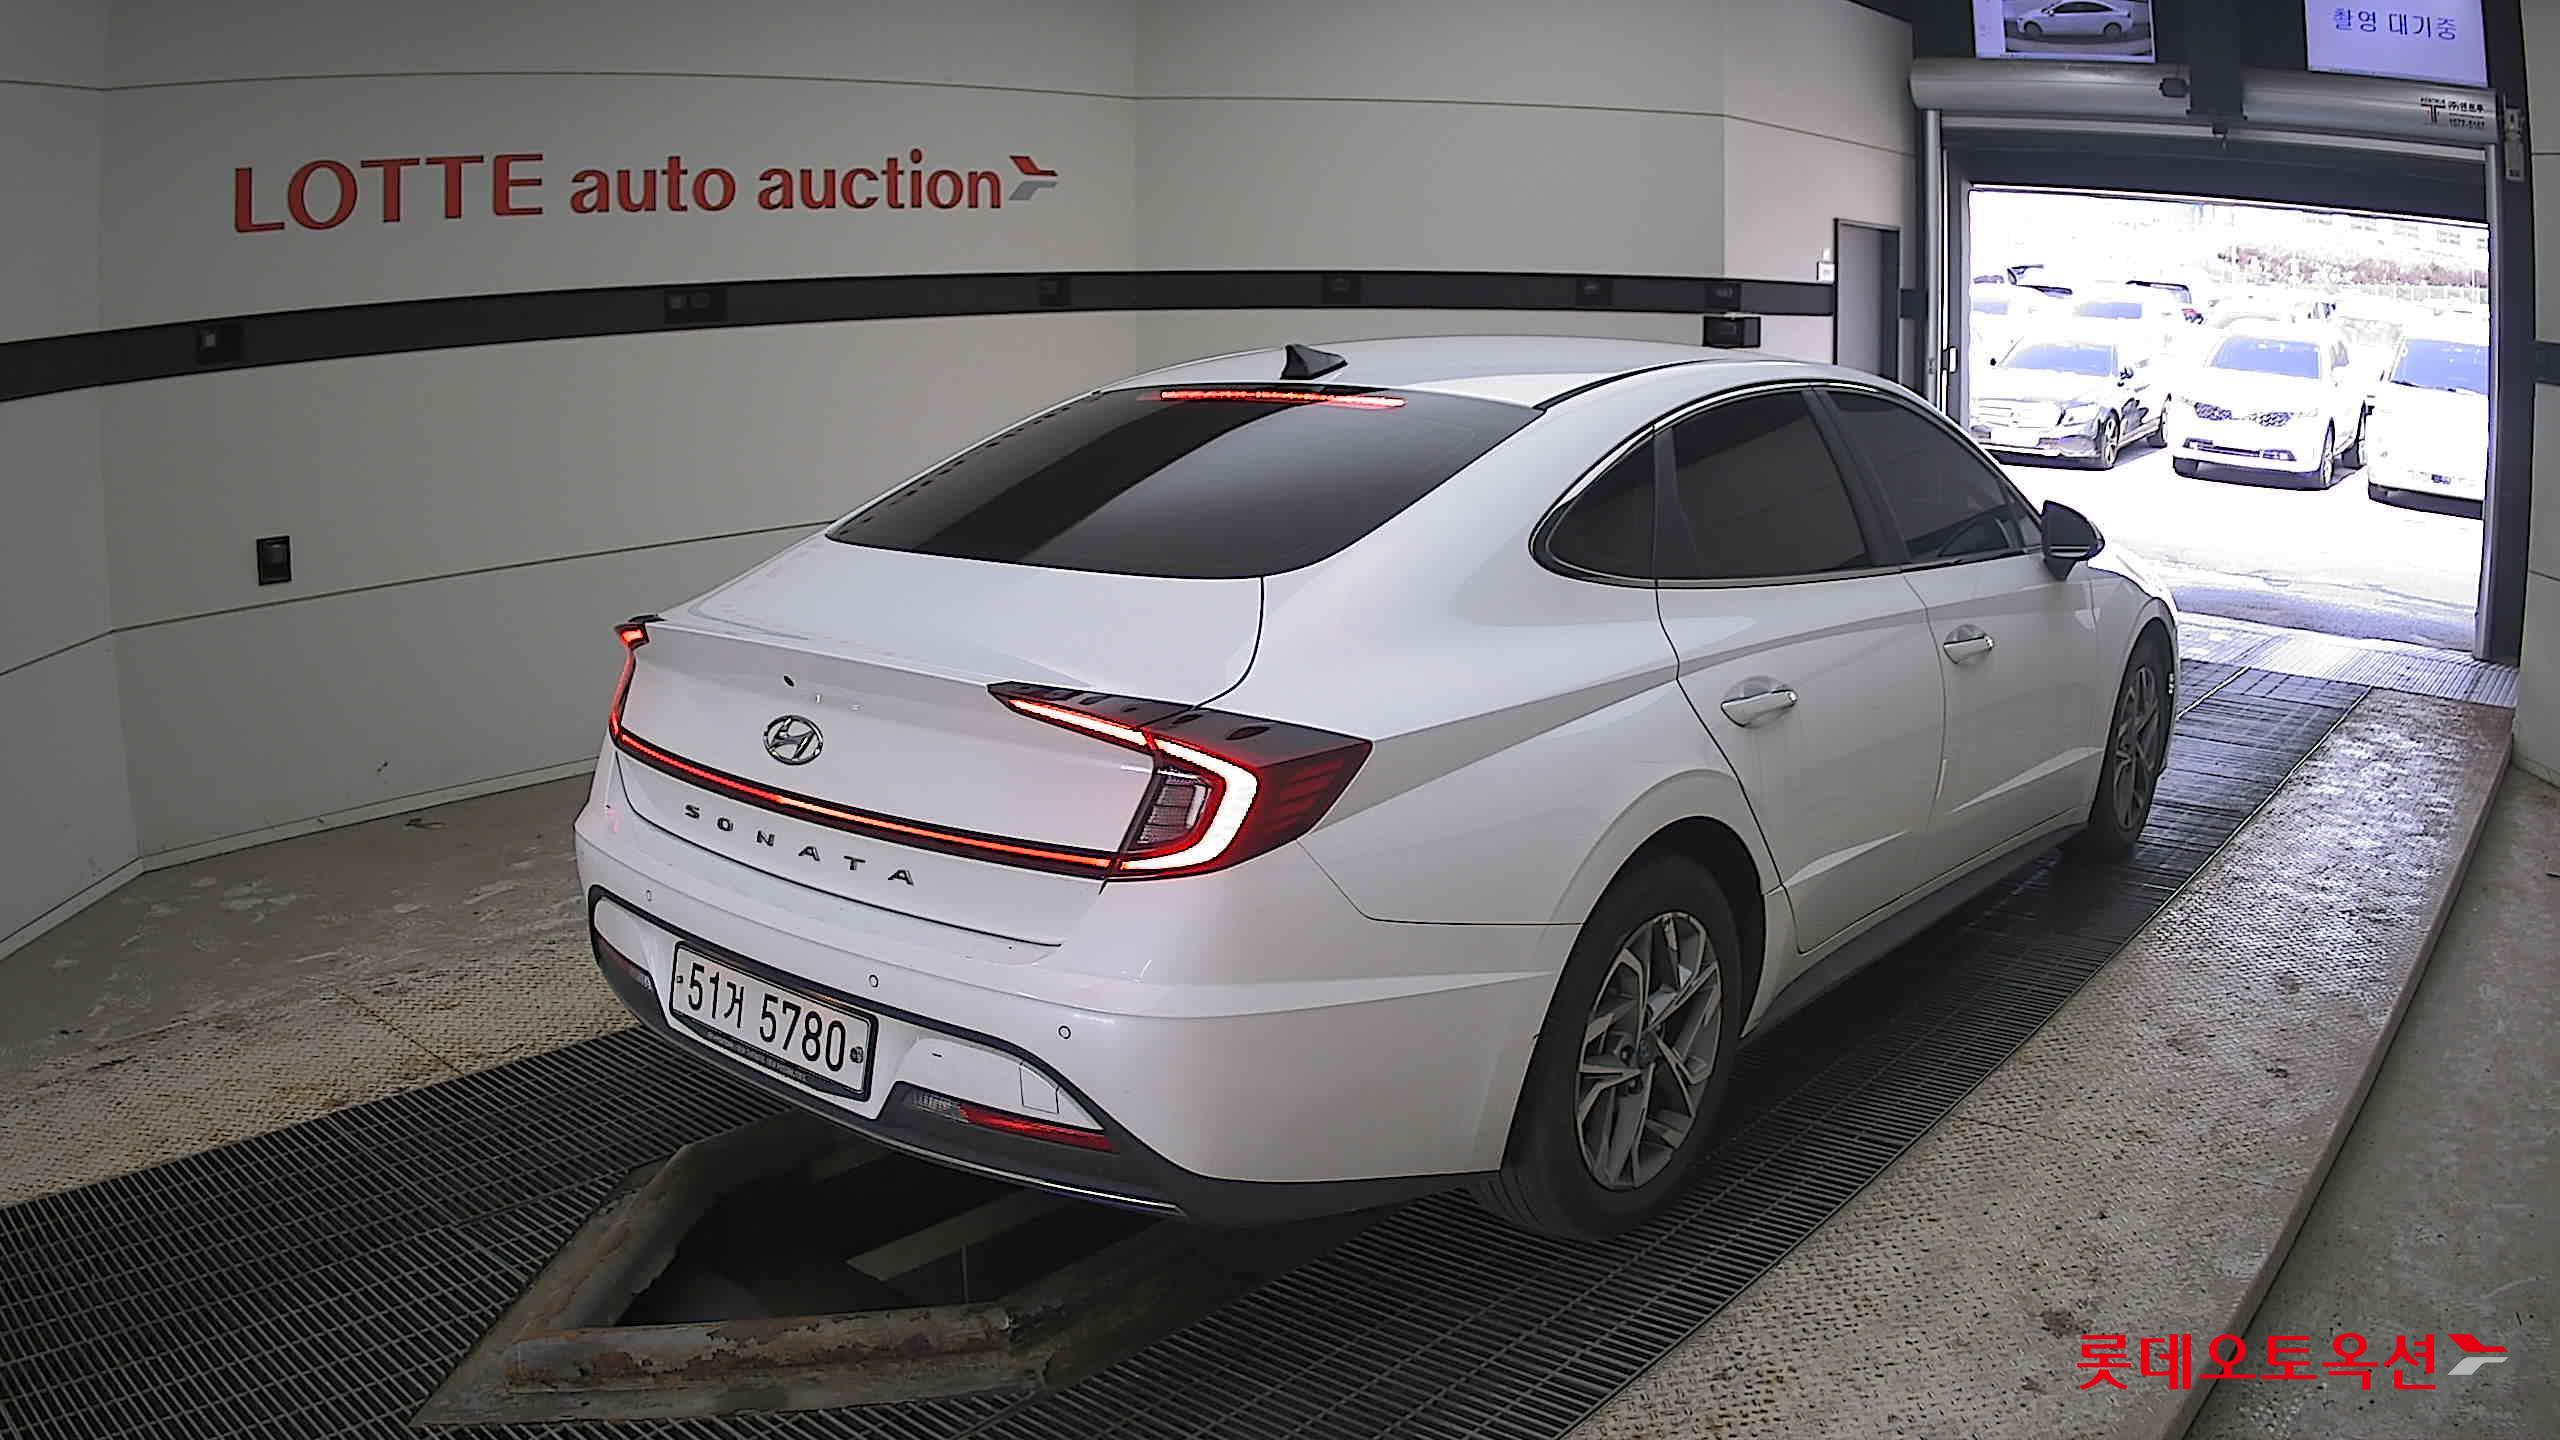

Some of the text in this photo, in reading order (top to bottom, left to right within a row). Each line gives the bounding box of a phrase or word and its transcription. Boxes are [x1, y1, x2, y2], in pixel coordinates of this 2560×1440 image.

[2334, 8, 2457, 41] 촬영 대기중
[235, 149, 1003, 233] LOTTE auto auction
[684, 804, 914, 886] SONATA
[688, 962, 745, 1029] 51거
[759, 993, 847, 1072] 5780
